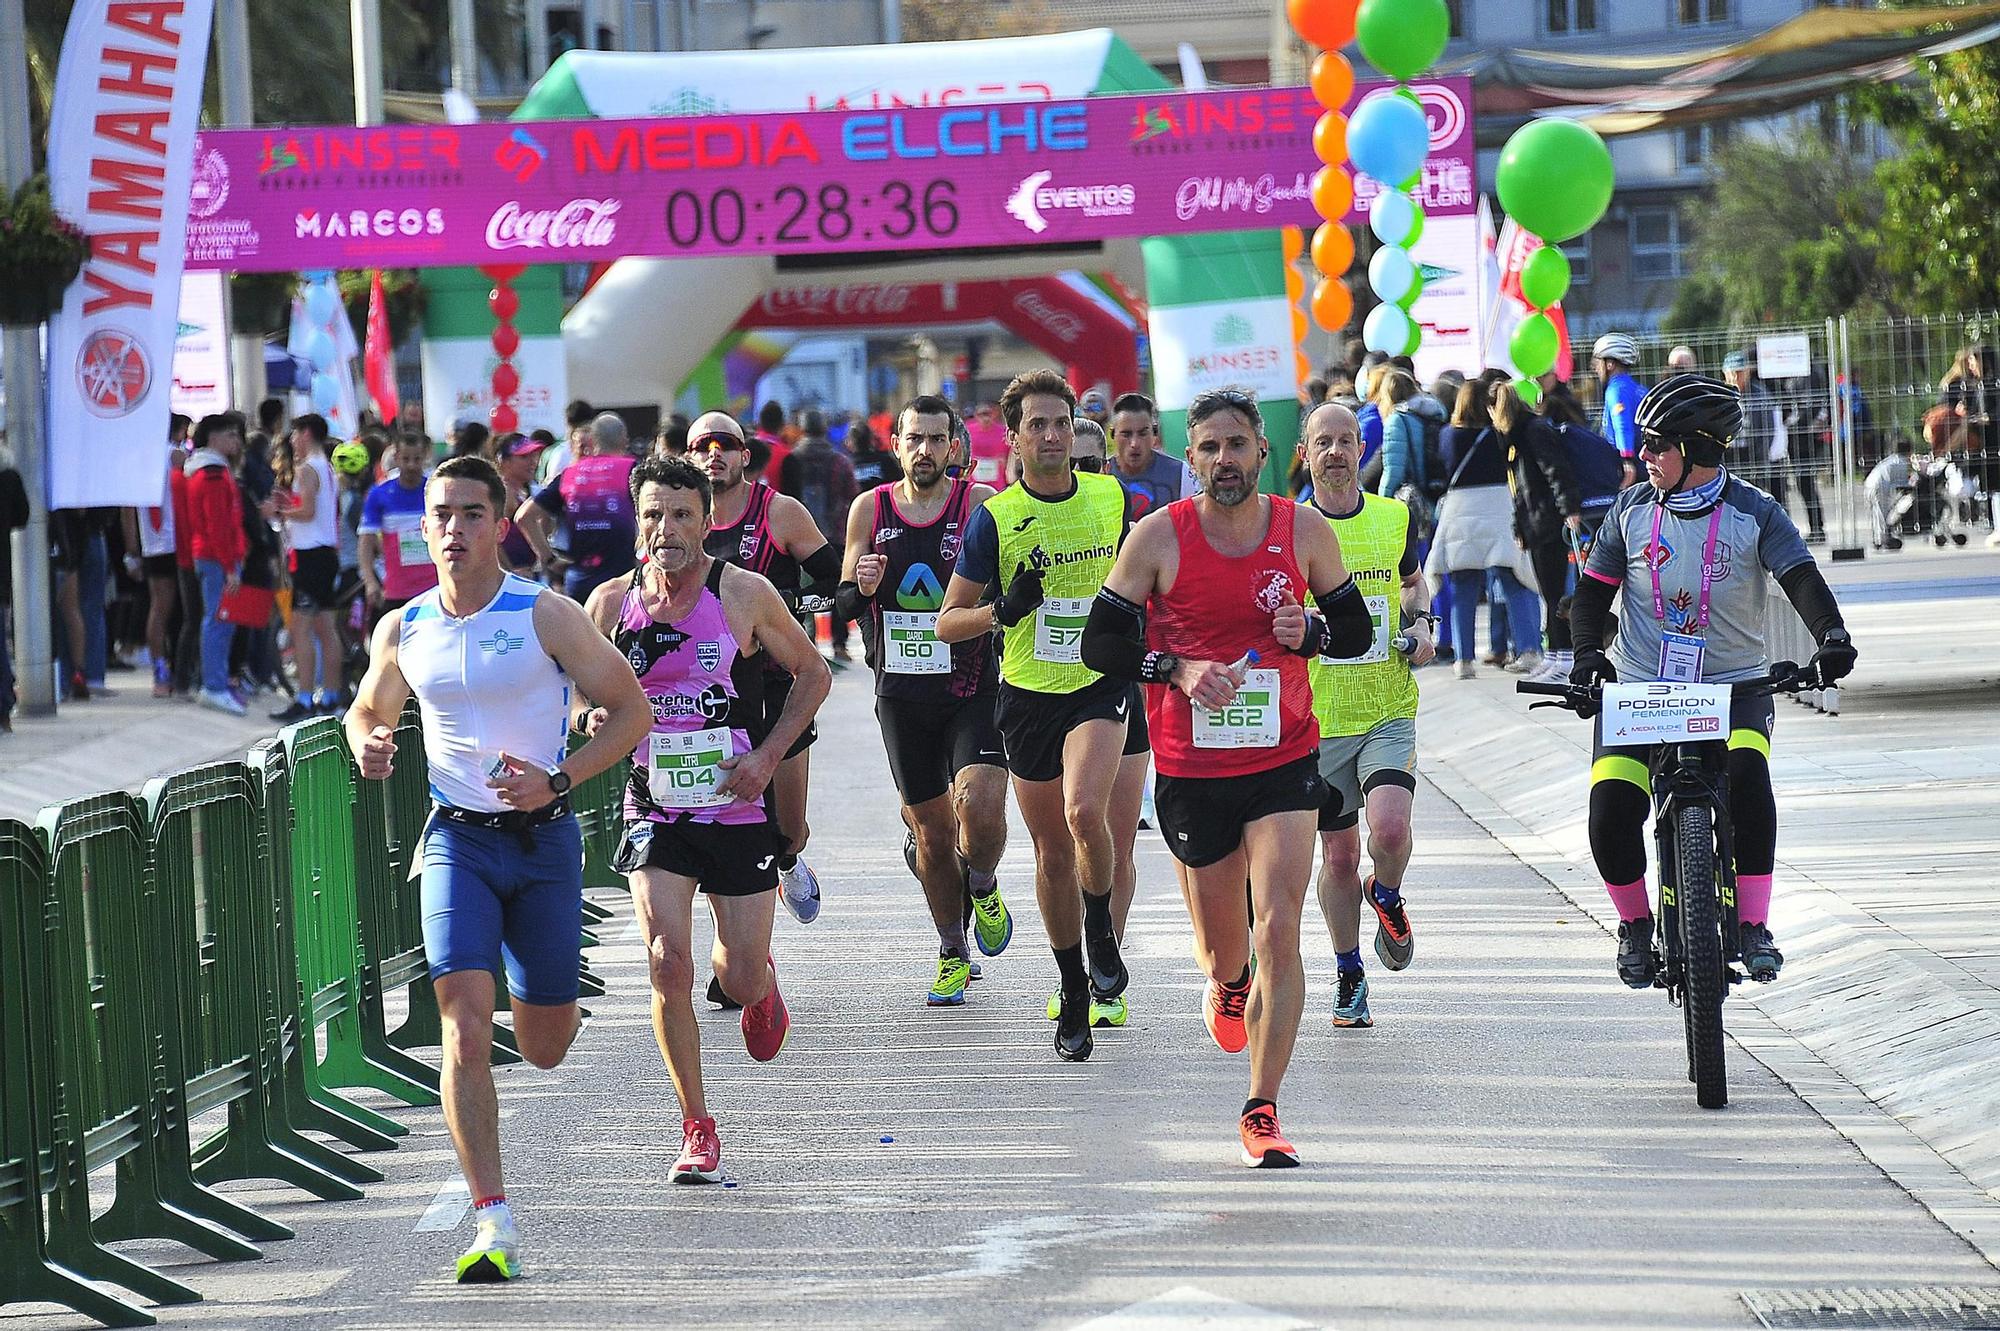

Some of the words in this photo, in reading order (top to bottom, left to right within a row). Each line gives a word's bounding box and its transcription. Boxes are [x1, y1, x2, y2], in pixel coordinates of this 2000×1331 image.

[572, 118, 821, 175] MEDIA
[842, 105, 1088, 160] ELCHE
[82, 1, 185, 318] YAMAHA
[1037, 185, 1135, 209] EVENTOS
[295, 208, 444, 238] MARCOS
[485, 198, 623, 249] Coca-Cola
[666, 181, 959, 246] 00:28:36
[1054, 545, 1114, 566] Running
[906, 631, 924, 641] DARIO
[1050, 629, 1081, 646] 37
[899, 643, 932, 657] 160
[1209, 708, 1263, 727] 362
[1632, 709, 1702, 718] FEMENINA
[668, 768, 715, 788] 104
